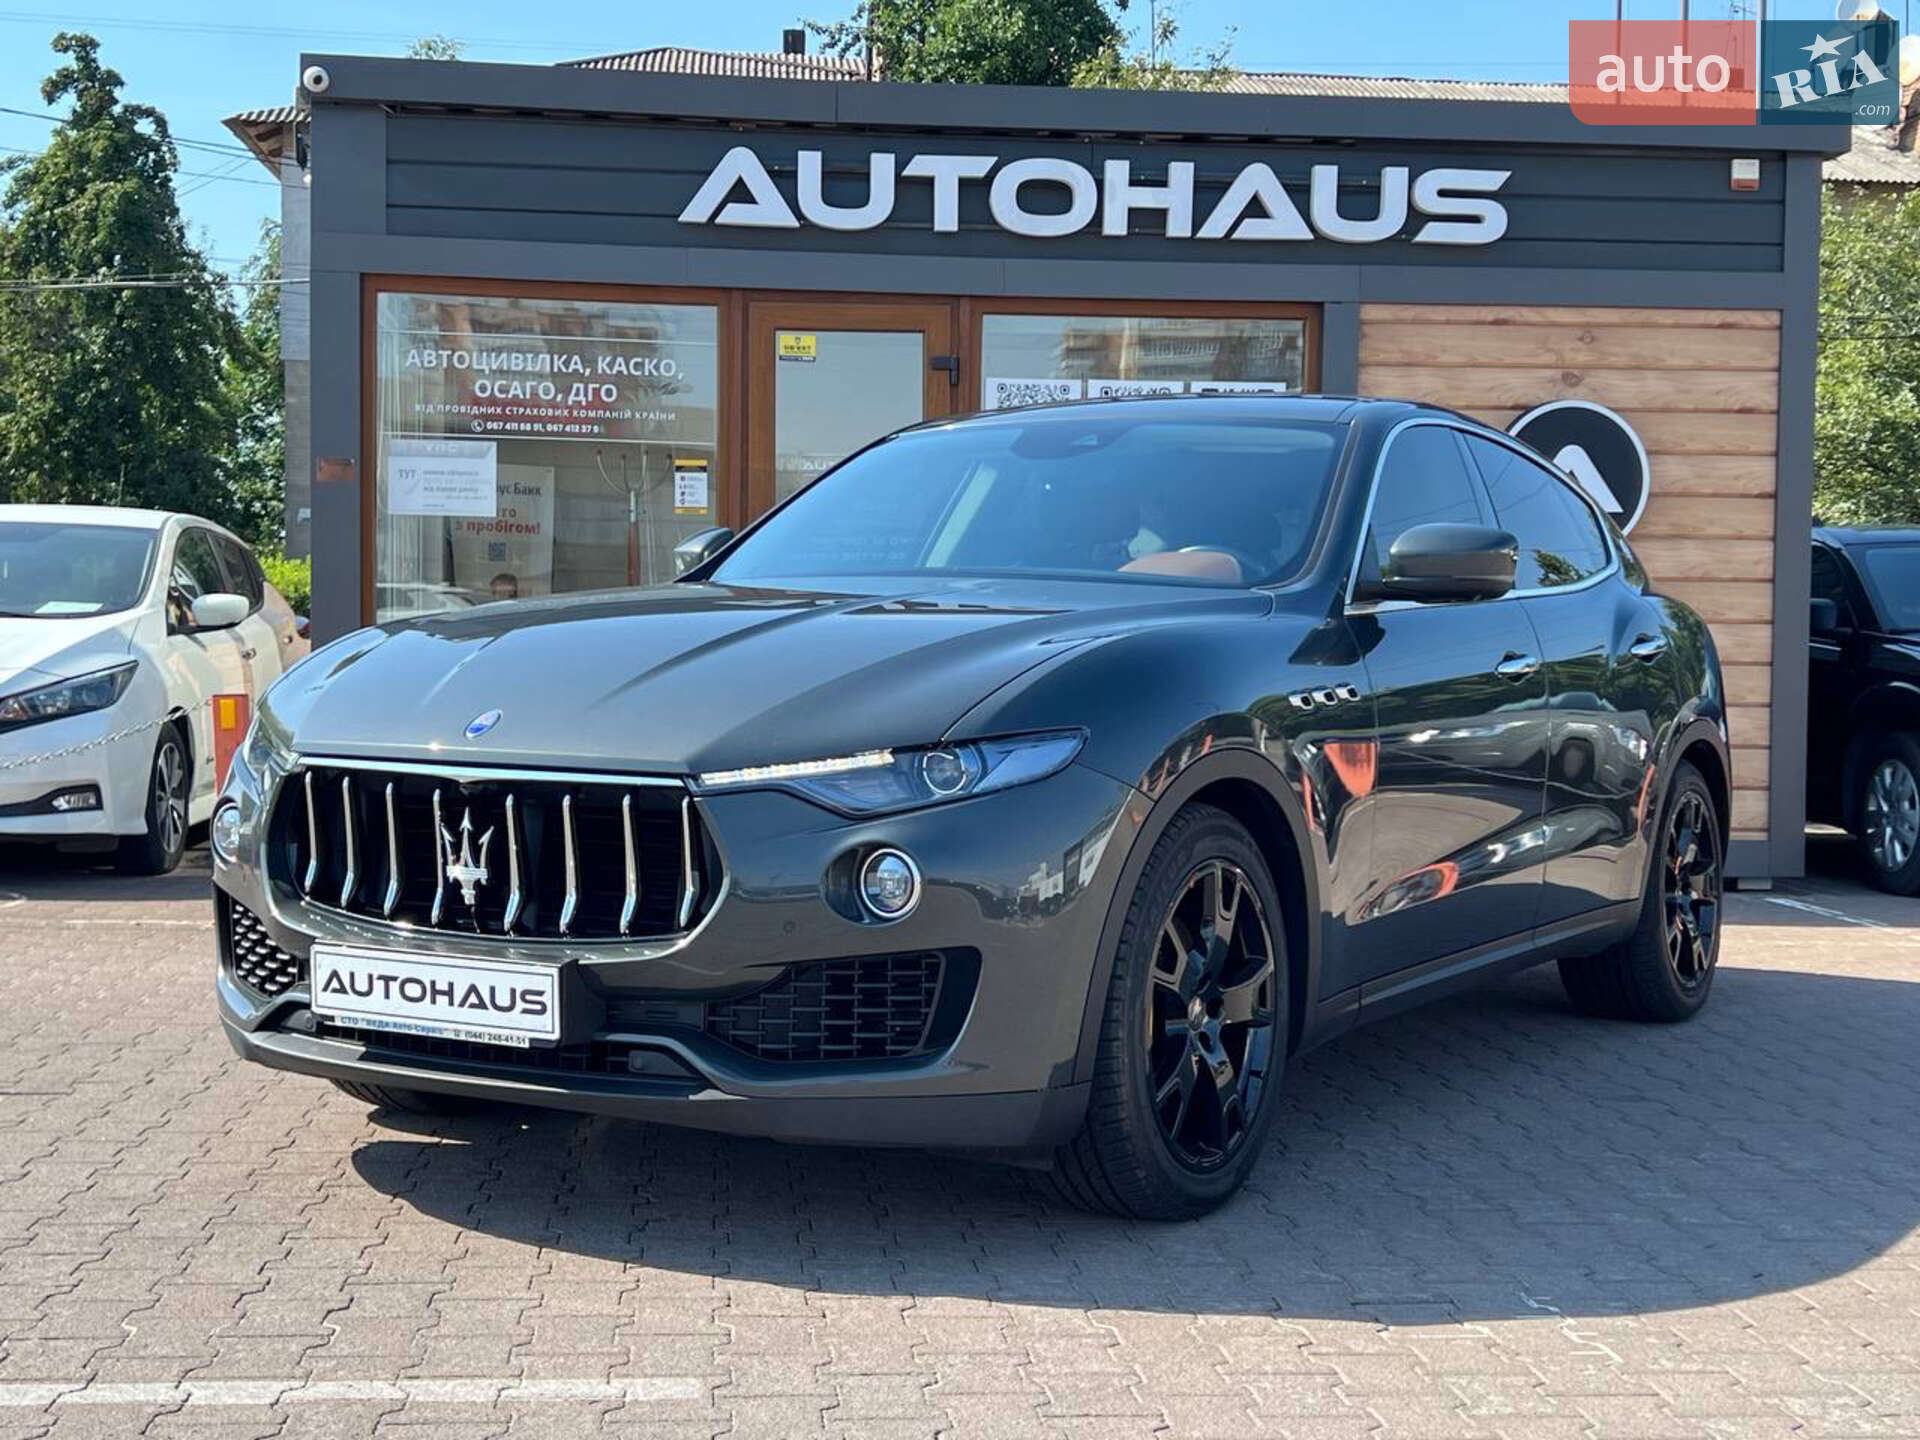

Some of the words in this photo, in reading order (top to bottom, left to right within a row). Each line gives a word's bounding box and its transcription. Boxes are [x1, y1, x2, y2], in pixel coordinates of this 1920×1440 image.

[677, 146, 1512, 246] AUTOHAUS
[405, 349, 592, 377] АВТОЦИВІЛКА,
[597, 355, 685, 380] КАСКО,
[474, 380, 563, 402] ОСАГО,
[567, 382, 617, 406] ДГО
[437, 403, 502, 417] ПРОВІДНИХ
[505, 406, 570, 418] СТРАХОВИХ
[572, 408, 633, 420] КОМПАНІЙ
[635, 410, 677, 421] КРАЇНИ
[467, 519, 540, 535] пробігом!
[321, 968, 548, 1016] AUTOHAUS
[341, 1016, 358, 1025] СТО
